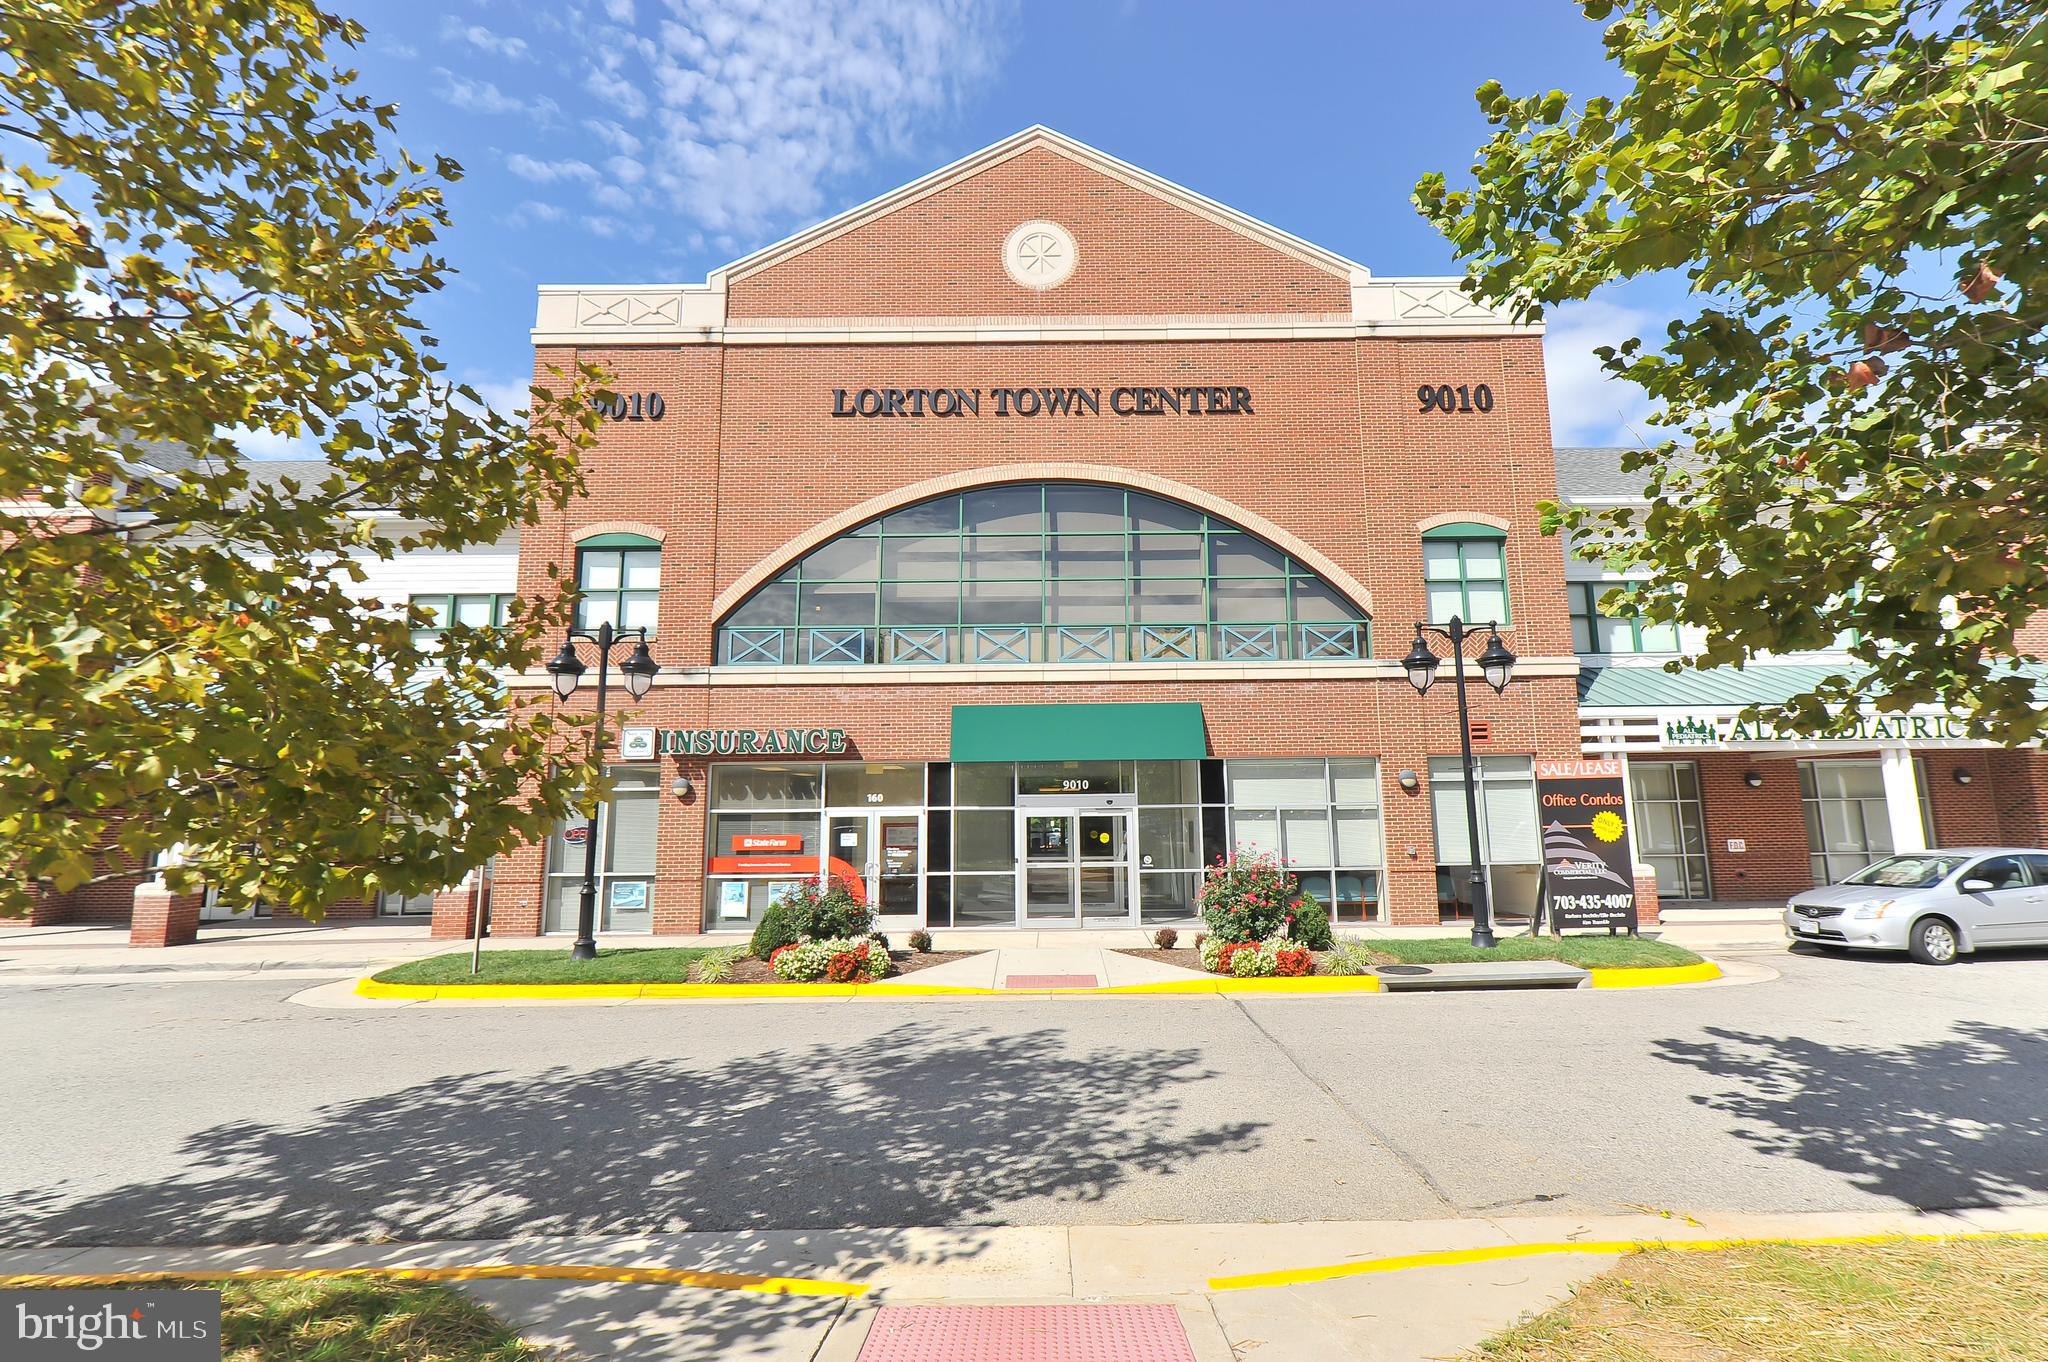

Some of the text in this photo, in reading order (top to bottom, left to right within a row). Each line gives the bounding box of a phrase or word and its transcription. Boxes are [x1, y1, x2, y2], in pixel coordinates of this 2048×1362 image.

[831, 386, 1255, 418] LORTON TOWN CENTER
[1417, 383, 1494, 415] 9010
[659, 728, 847, 755] INSURANCE
[1540, 761, 1620, 777] SALE/LEASE
[1063, 779, 1089, 790] 9010
[866, 793, 884, 803] 160
[1542, 792, 1624, 807] Office Condos
[1574, 861, 1606, 870] VERITY
[1553, 894, 1633, 910] 703-435-4007
